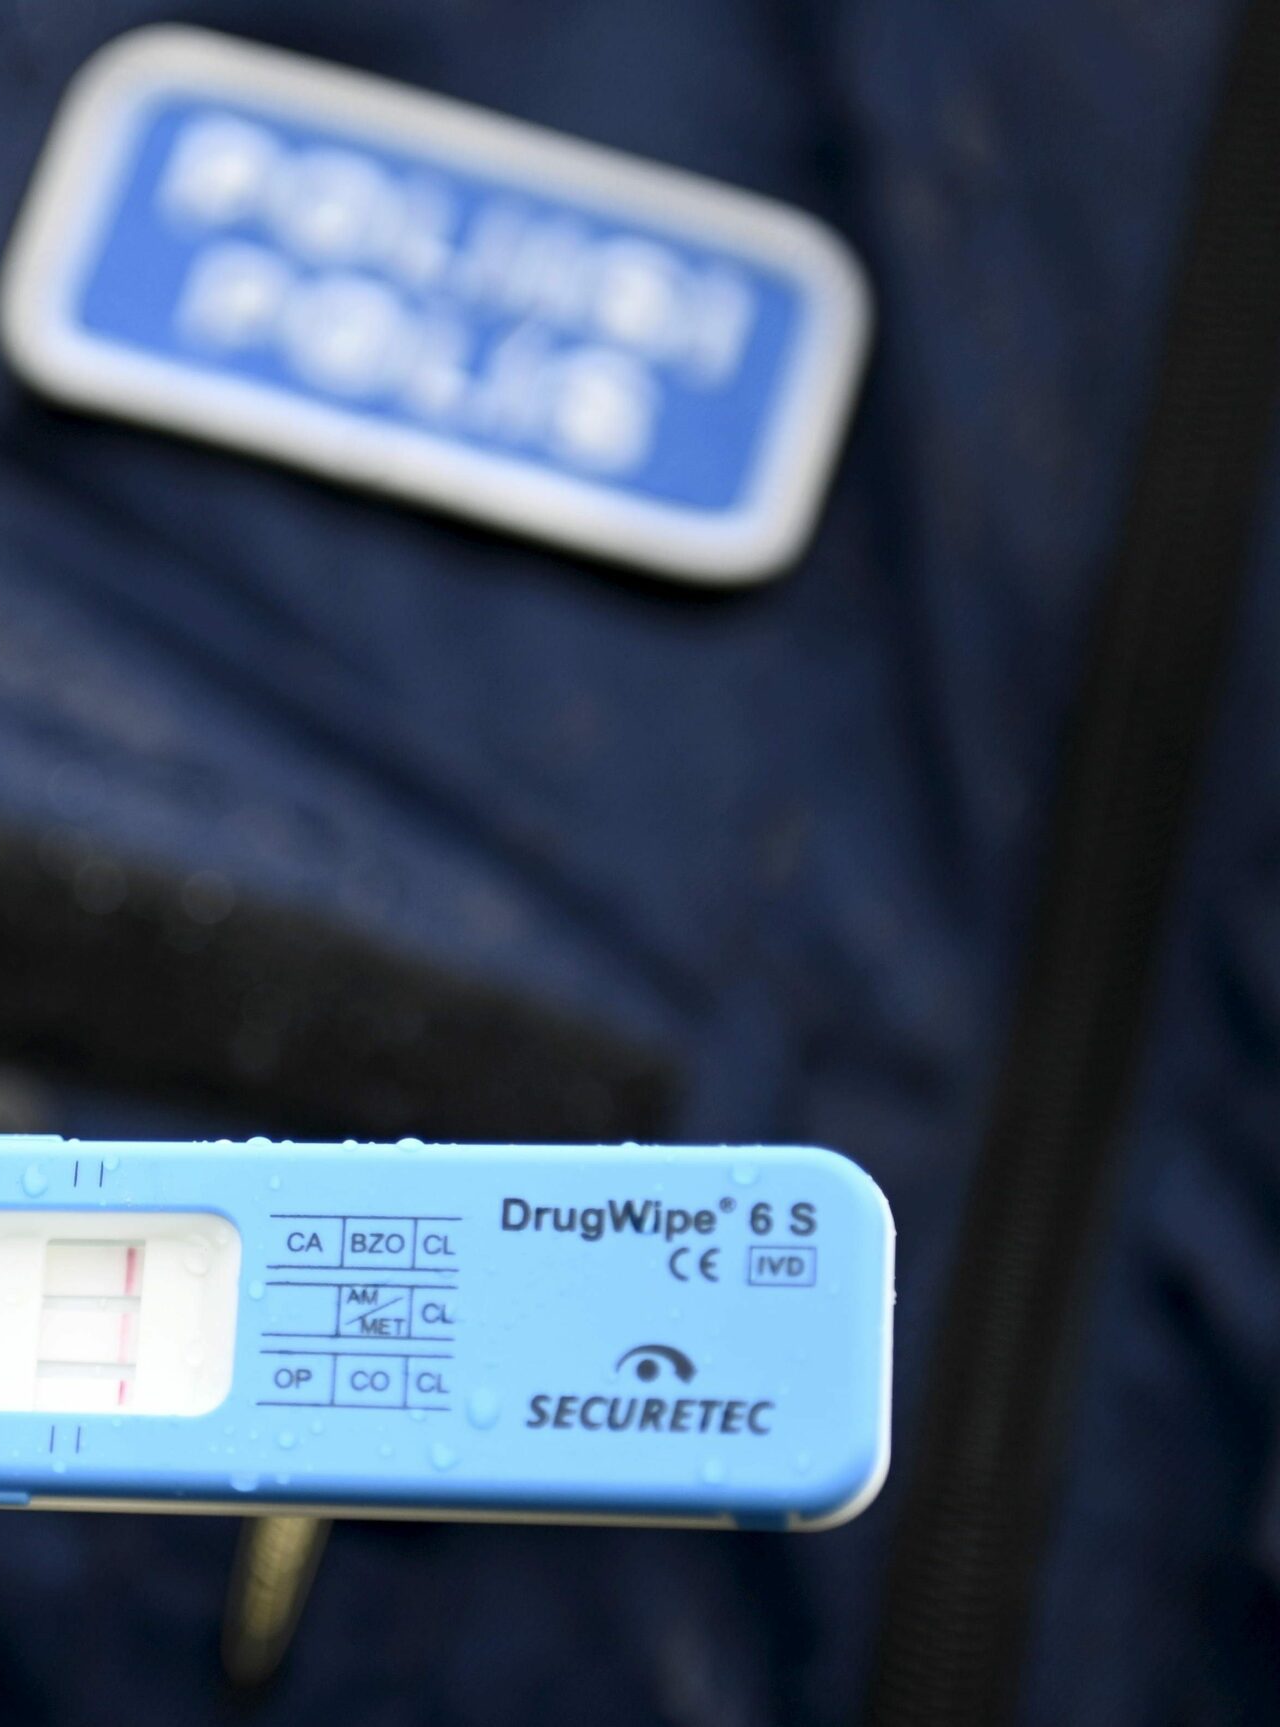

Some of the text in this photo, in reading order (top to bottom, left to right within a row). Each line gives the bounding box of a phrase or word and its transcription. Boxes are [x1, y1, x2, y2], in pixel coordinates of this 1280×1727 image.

[749, 1201, 773, 1236] 6
[789, 1201, 817, 1236] S
[286, 1232, 456, 1255] CA BZO CL
[757, 1256, 805, 1277] IVD
[346, 1289, 378, 1304] AM
[421, 1303, 455, 1324] CL
[360, 1318, 405, 1335] MET
[273, 1368, 450, 1393] OP CO CL
[526, 1394, 775, 1436] SECURETEC
